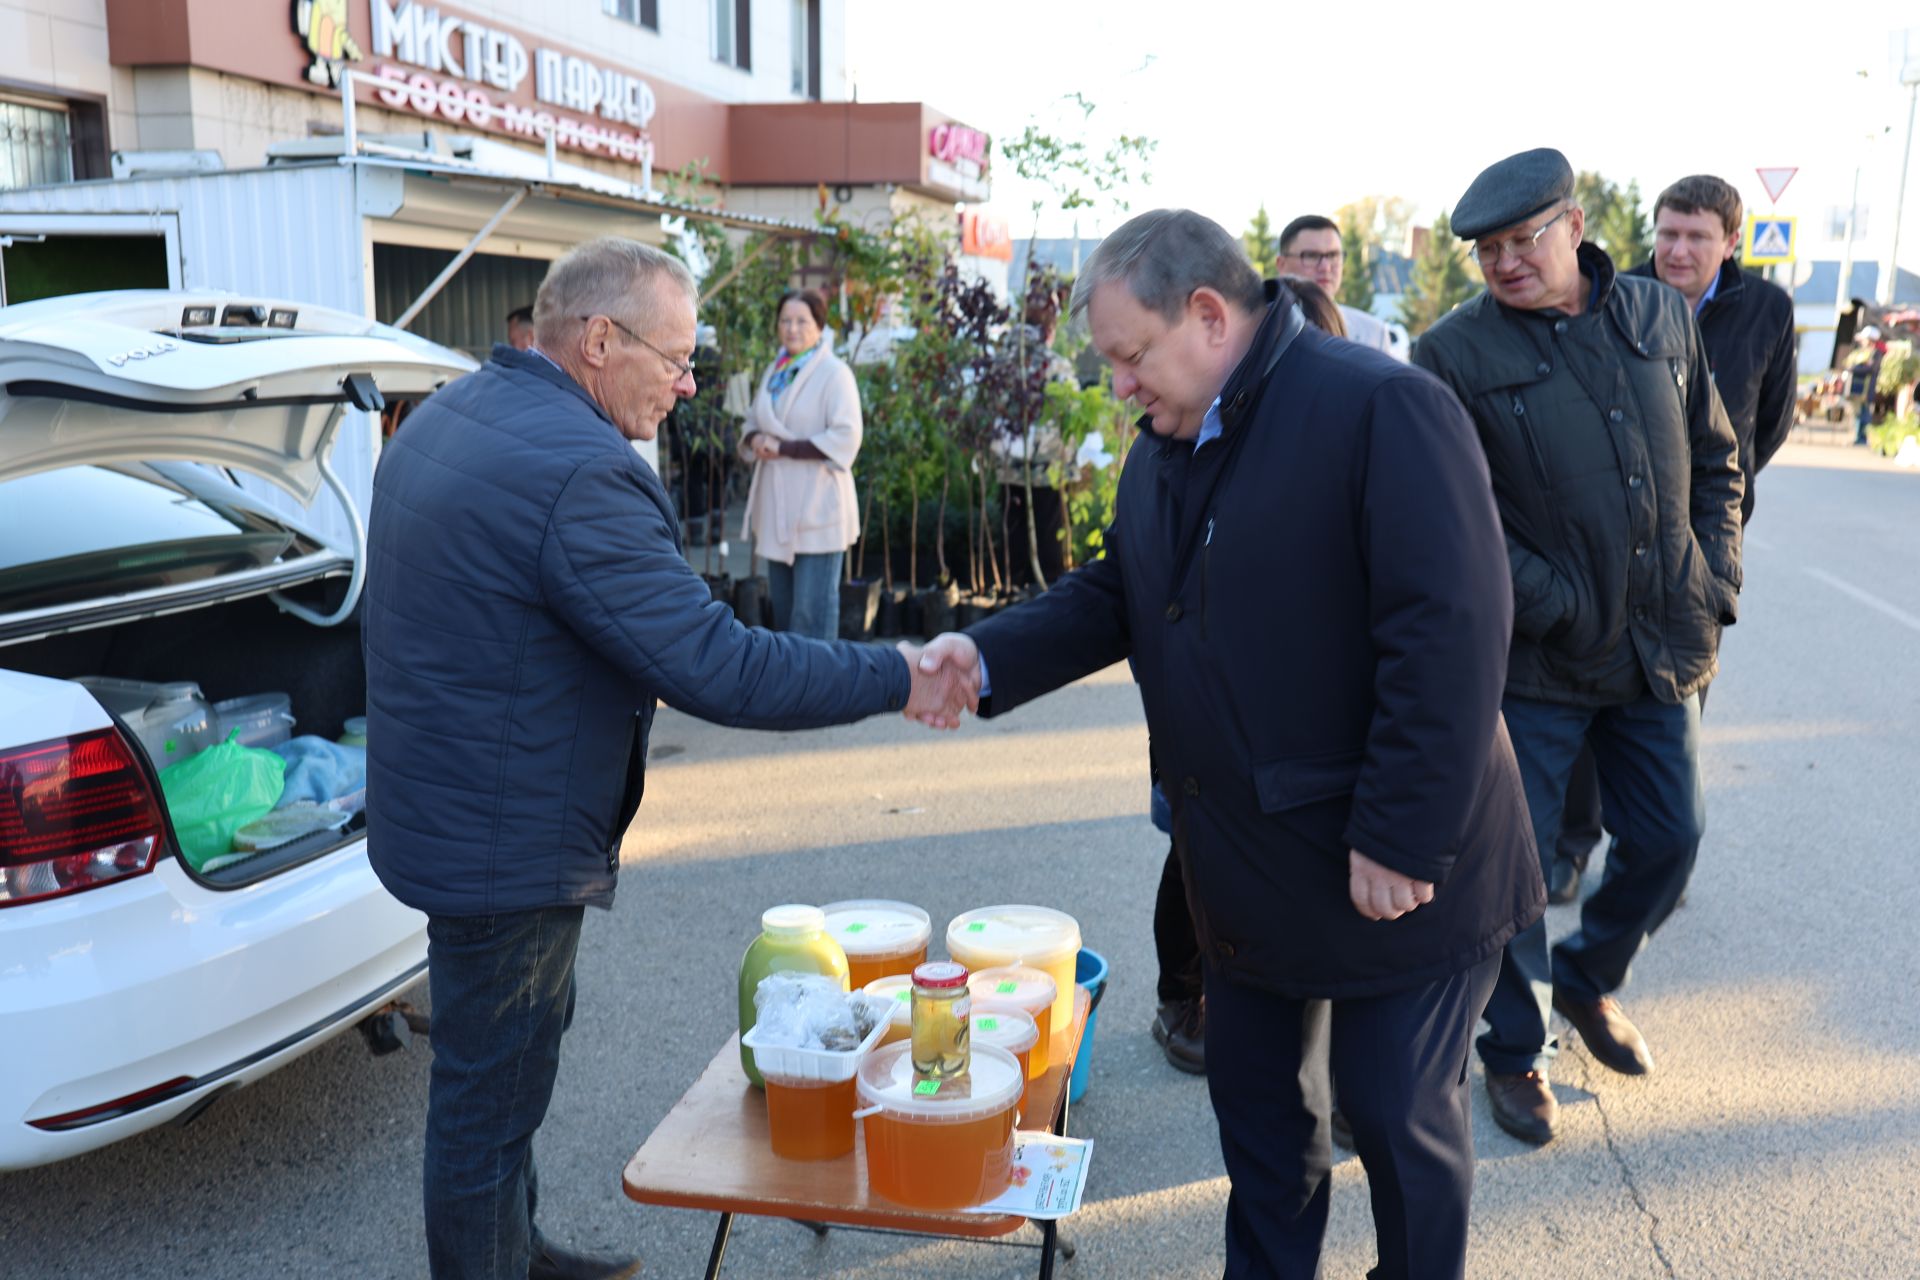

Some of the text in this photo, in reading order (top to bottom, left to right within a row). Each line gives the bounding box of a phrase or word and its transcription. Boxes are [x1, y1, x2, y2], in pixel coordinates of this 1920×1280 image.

[372, 0, 655, 128] МИСТЕР ПАРКЕР
[377, 65, 490, 126] 5000
